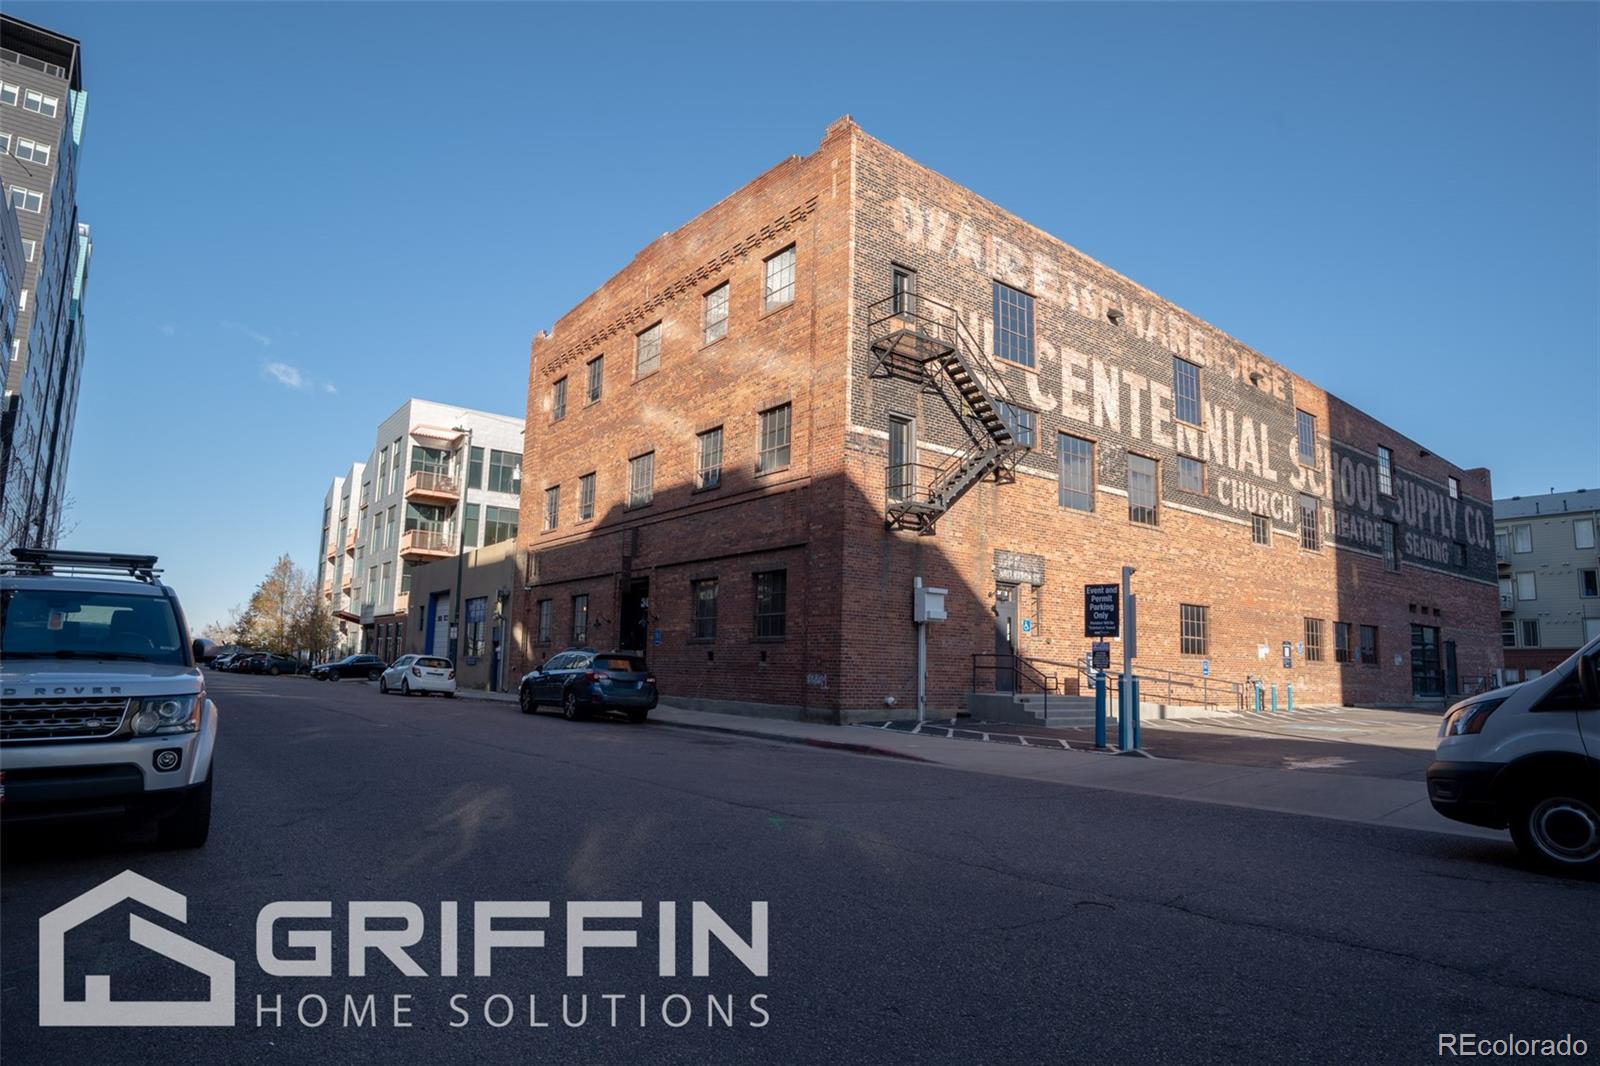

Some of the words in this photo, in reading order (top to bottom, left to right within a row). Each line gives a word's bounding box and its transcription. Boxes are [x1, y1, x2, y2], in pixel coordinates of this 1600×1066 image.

[1391, 476, 1458, 540] SUPPLY
[1464, 505, 1491, 550] CO.
[1217, 476, 1294, 523] CHURCH
[1321, 506, 1382, 547] THEATRE
[1405, 531, 1449, 564] SEATING
[1086, 586, 1104, 594] Event
[1105, 586, 1117, 594] and
[1091, 594, 1113, 603] Permit
[1089, 602, 1115, 612] Parking
[1093, 611, 1109, 620] Only
[34, 686, 122, 696] ROVER
